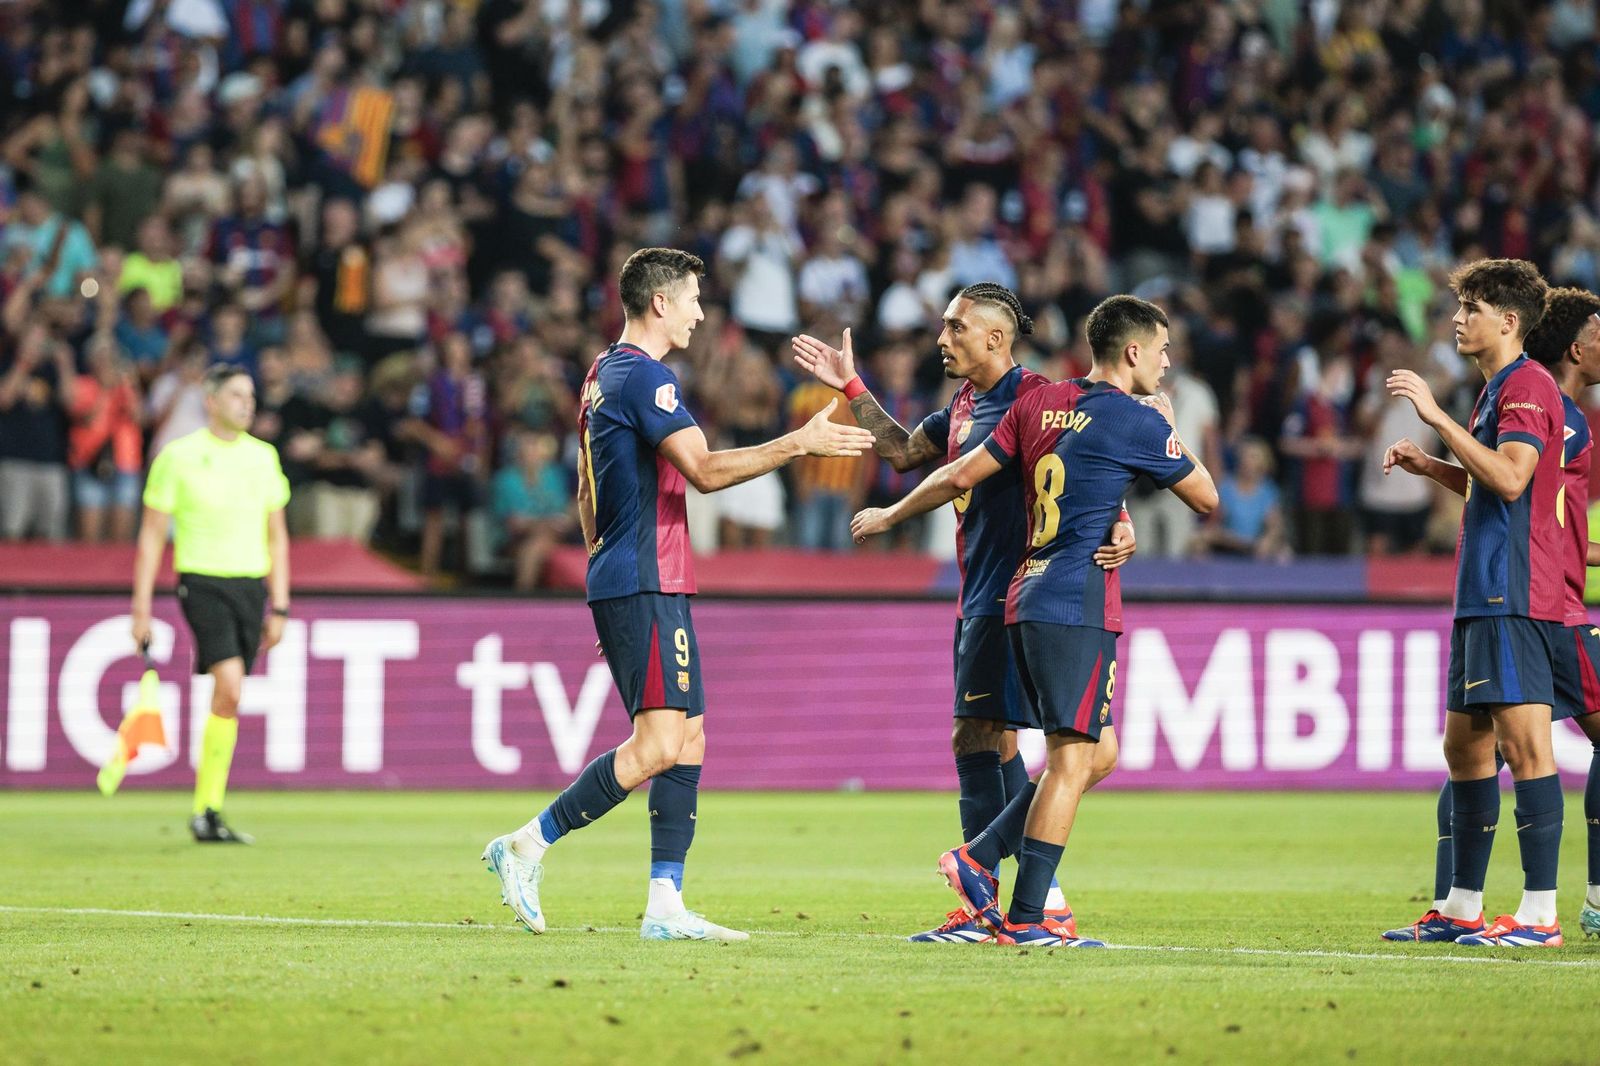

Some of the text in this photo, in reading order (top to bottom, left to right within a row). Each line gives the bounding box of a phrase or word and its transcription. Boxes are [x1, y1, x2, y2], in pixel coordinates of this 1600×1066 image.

[1041, 410, 1092, 433] PEDRI
[1503, 402, 1537, 411] AMBILIGHT
[1032, 453, 1066, 548] 8
[674, 627, 689, 667] 9
[1105, 660, 1117, 700] 8
[456, 632, 614, 775] tv
